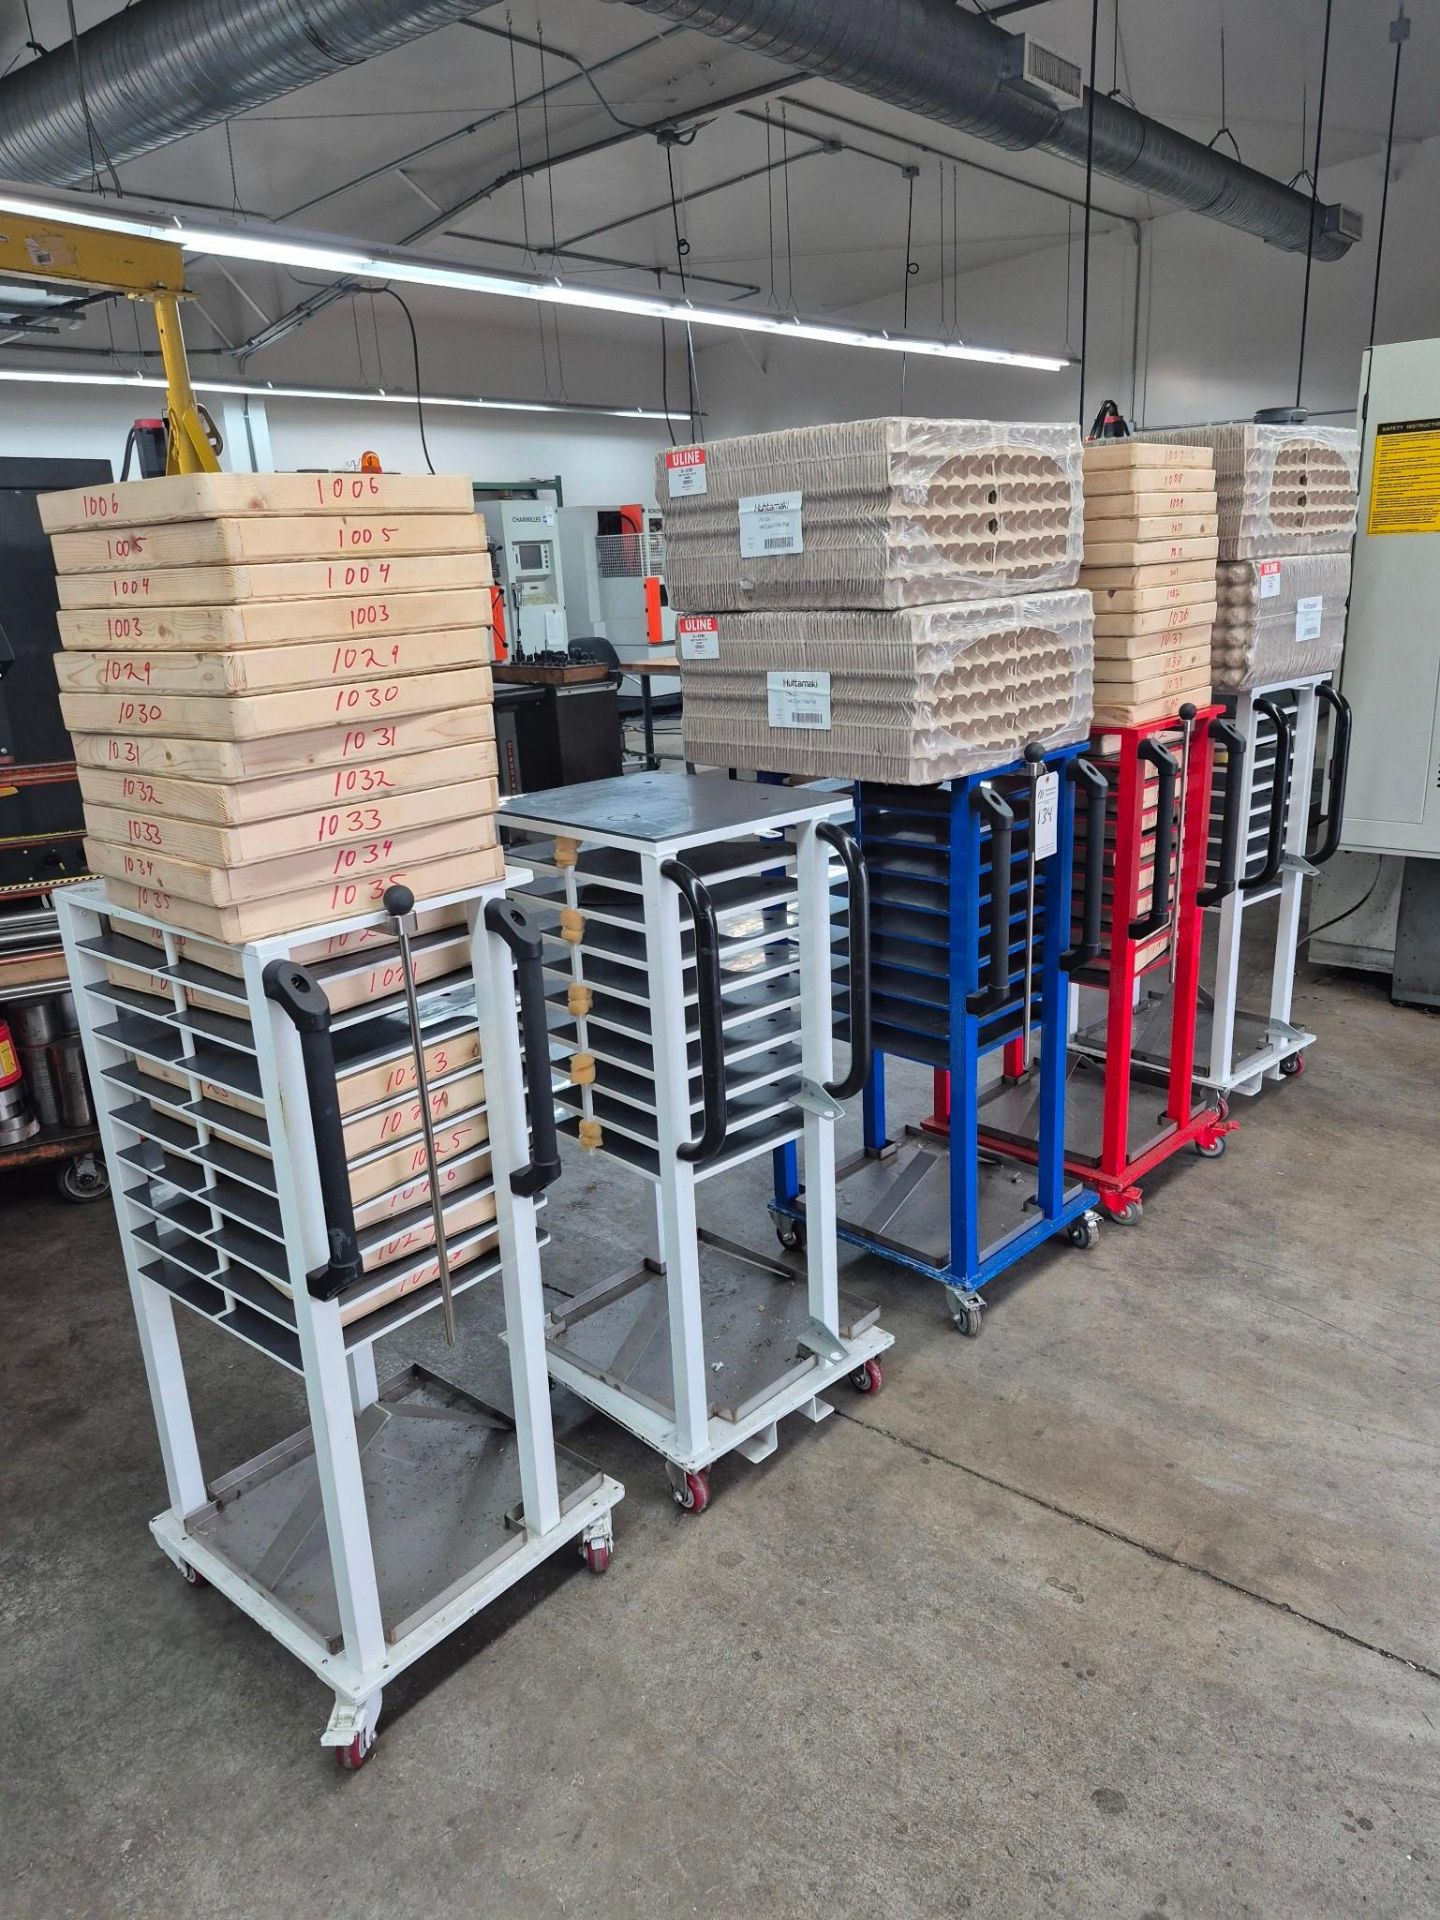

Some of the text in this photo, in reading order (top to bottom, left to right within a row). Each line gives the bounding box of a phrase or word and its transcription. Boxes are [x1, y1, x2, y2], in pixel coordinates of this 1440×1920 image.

[672, 450, 701, 467] ULINE
[318, 477, 380, 505] 1006
[83, 493, 119, 518] 1006
[107, 536, 148, 559] 1005
[338, 527, 399, 548] 1005
[113, 577, 150, 597] 1004
[328, 563, 391, 589] 1004
[107, 618, 143, 640] 1003
[350, 604, 390, 630] 1003
[685, 618, 713, 632] ULINE
[105, 659, 151, 685] 1029
[332, 645, 400, 674] 1029
[335, 685, 400, 711] 1030
[118, 702, 162, 723] 1030
[108, 741, 140, 767] 1031
[342, 726, 396, 756] 1031
[122, 777, 163, 805] 1032
[335, 769, 398, 797] 1032
[319, 809, 382, 841] 1033
[1037, 806, 1053, 825] 134
[128, 819, 162, 846] 1033
[124, 855, 154, 876] 1034
[333, 840, 393, 875] 1034
[138, 886, 171, 909] 1035
